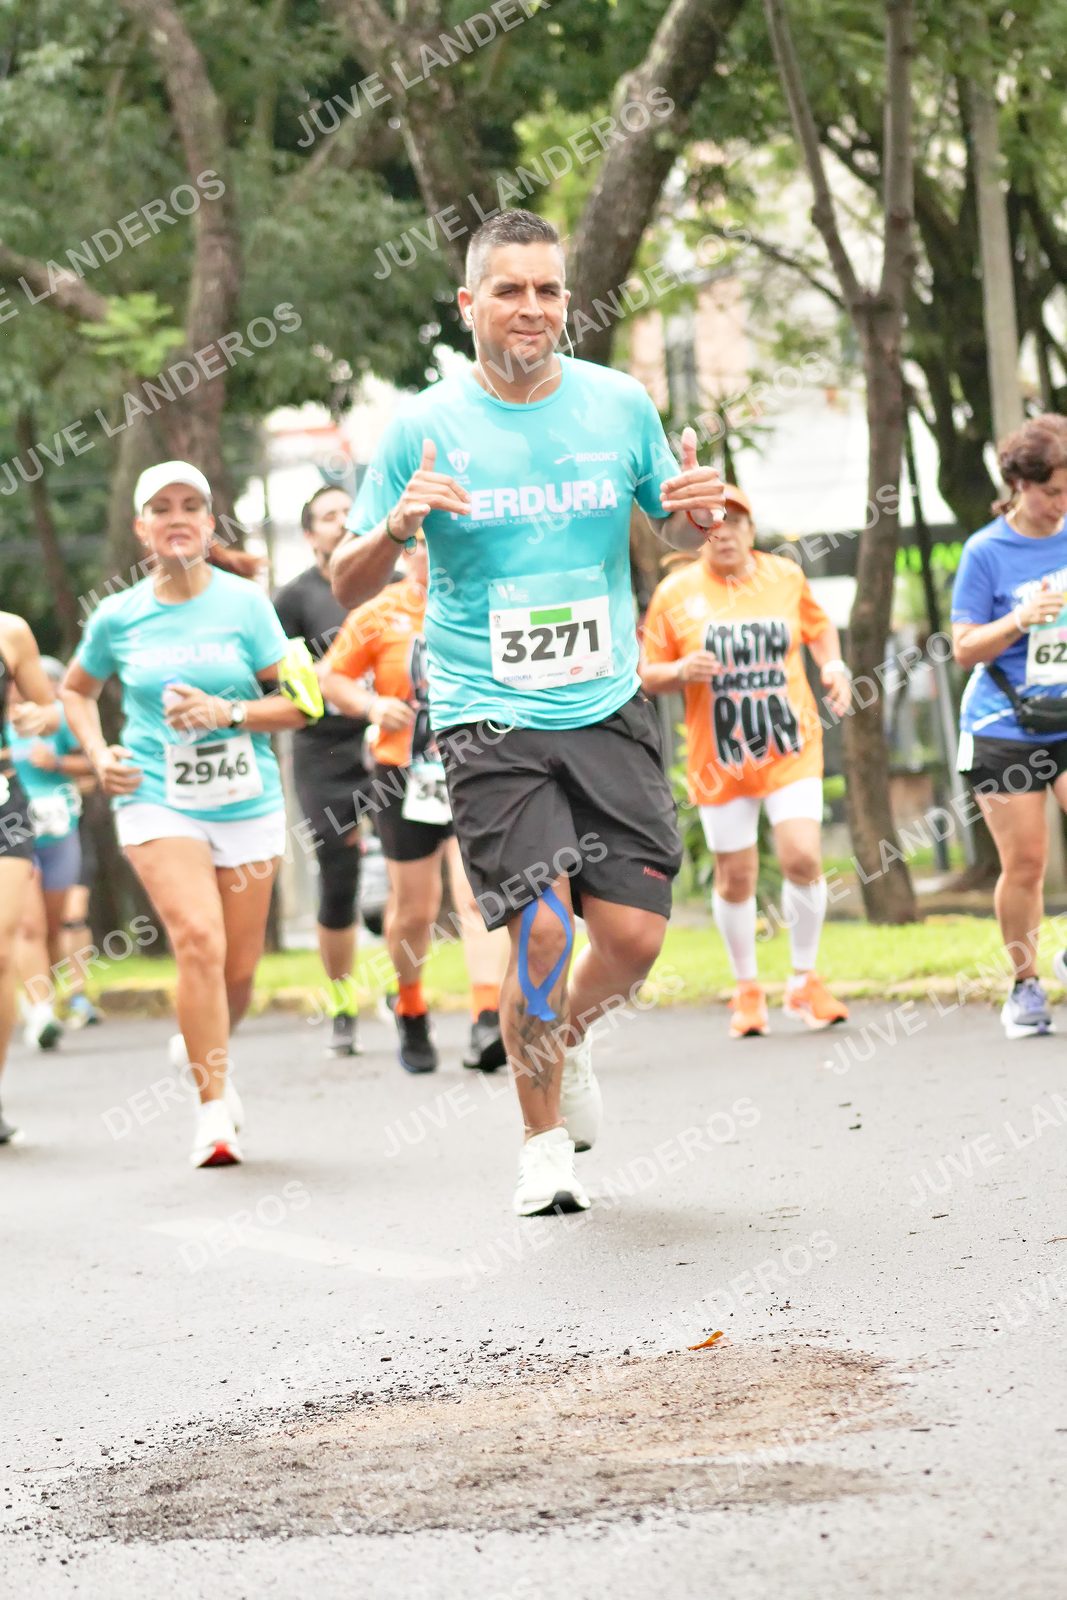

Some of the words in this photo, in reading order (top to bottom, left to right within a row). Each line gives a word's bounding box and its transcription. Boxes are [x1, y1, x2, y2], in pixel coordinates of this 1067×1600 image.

[575, 452, 618, 462] BROOKS
[451, 479, 618, 521] ERDURA
[500, 619, 600, 664] 3271
[713, 694, 800, 766] RUN
[174, 752, 249, 785] 2946
